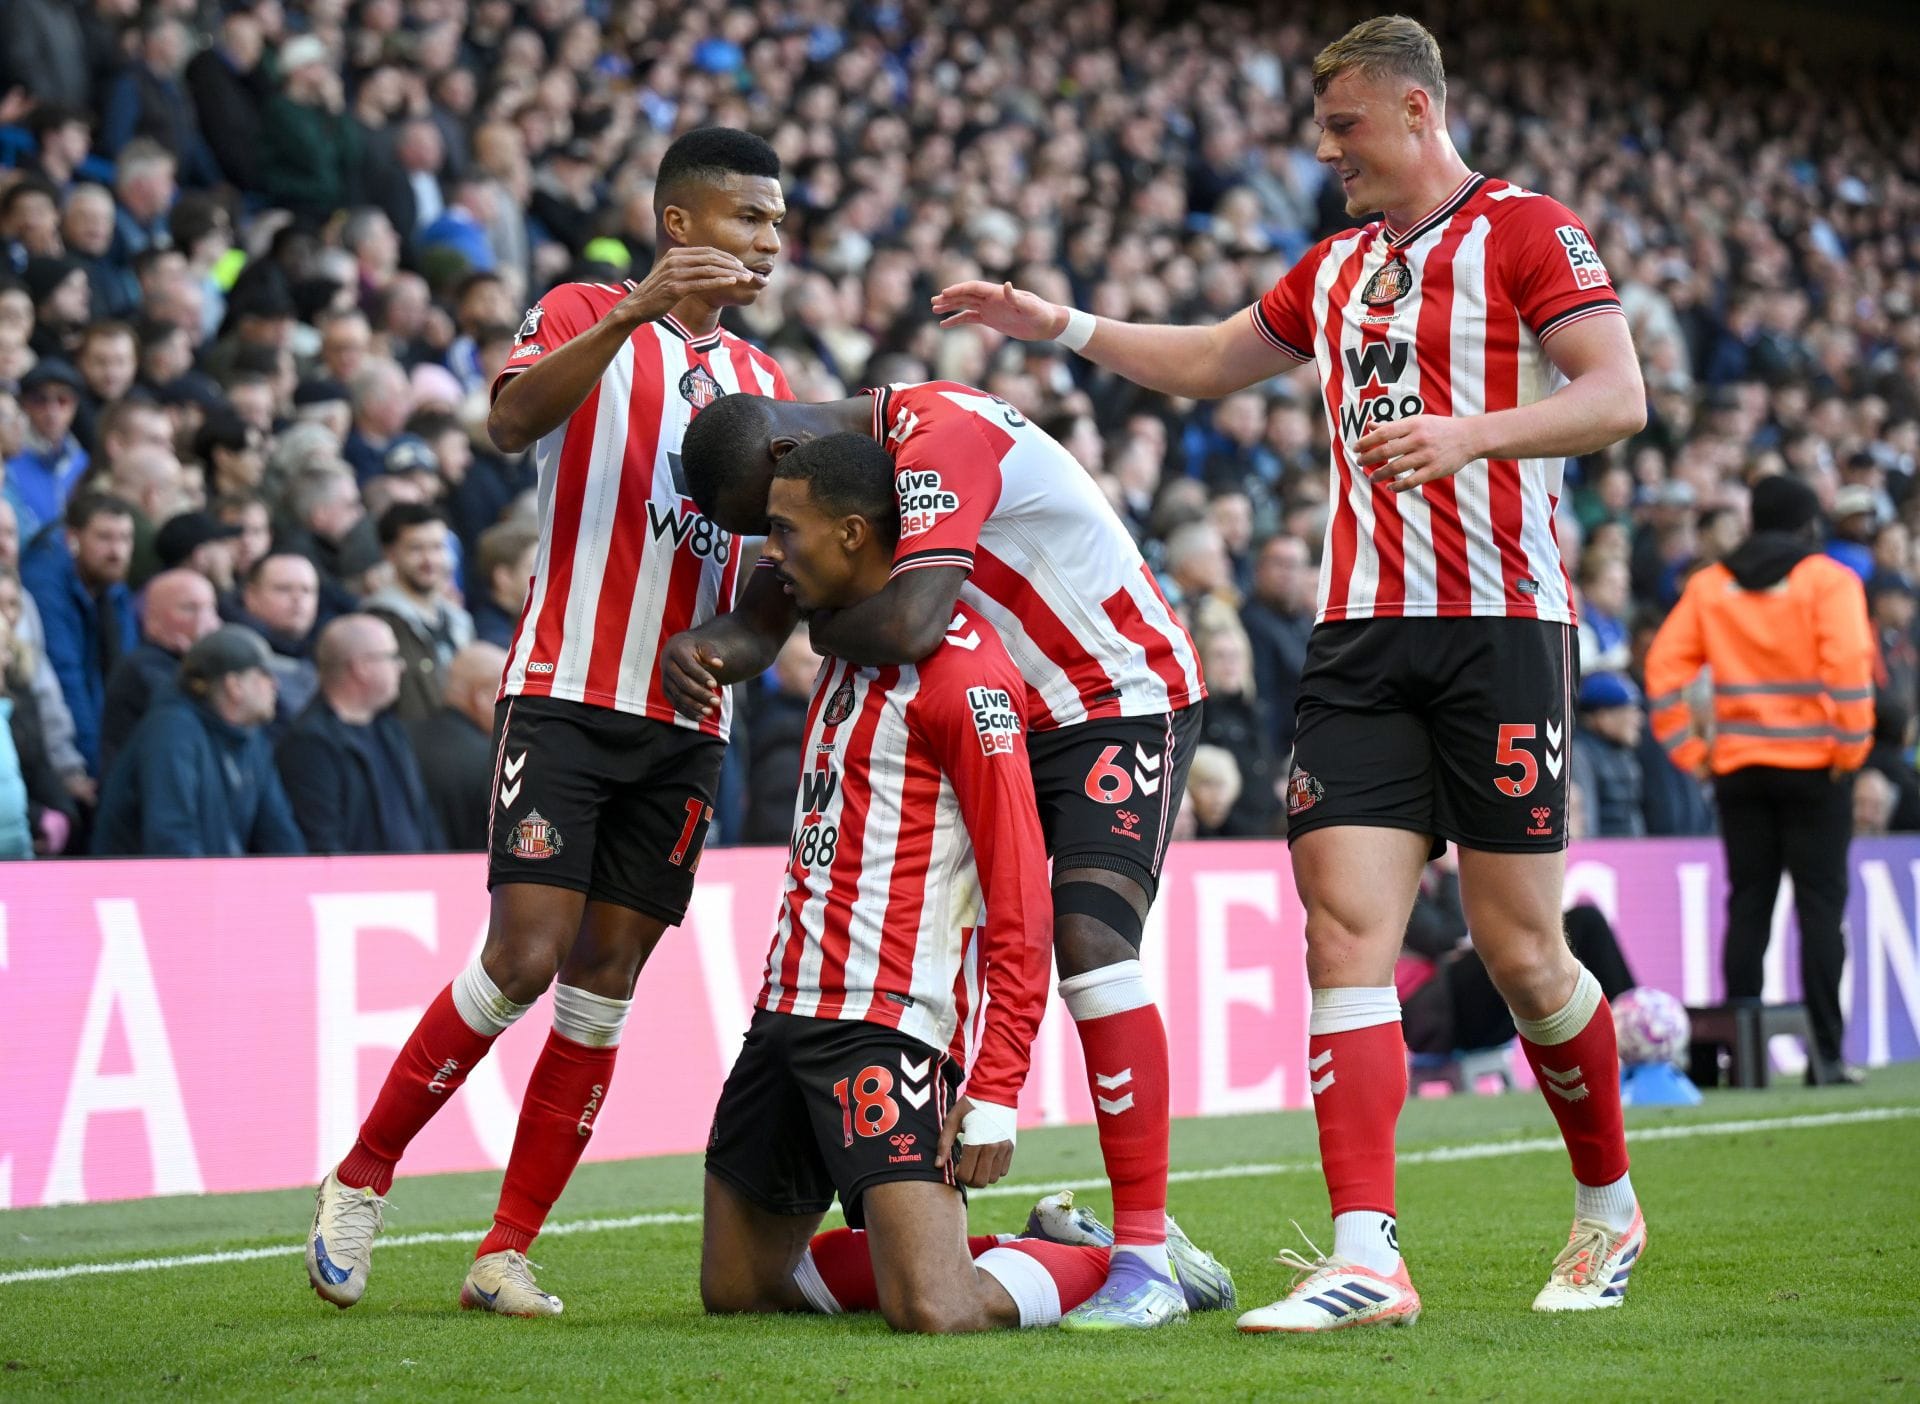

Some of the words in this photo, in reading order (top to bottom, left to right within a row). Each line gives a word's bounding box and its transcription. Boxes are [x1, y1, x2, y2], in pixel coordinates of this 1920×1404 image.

[1558, 227, 1587, 246] Liv
[1568, 246, 1600, 267] Sco
[897, 472, 938, 494] Live
[900, 493, 955, 515] Score
[648, 502, 730, 562] W88
[901, 512, 931, 535] Bet
[969, 689, 1008, 710] Live
[975, 711, 1020, 732] Score
[980, 731, 1012, 753] Bet
[1493, 723, 1539, 797] 5
[1084, 745, 1133, 804] 6
[668, 797, 714, 873] 1
[1111, 825, 1141, 841] hummel
[1527, 826, 1552, 836] hummel
[0, 890, 207, 1208] A
[576, 1084, 604, 1147] SAFC
[834, 1065, 900, 1148] 18
[888, 1152, 922, 1163] hummel
